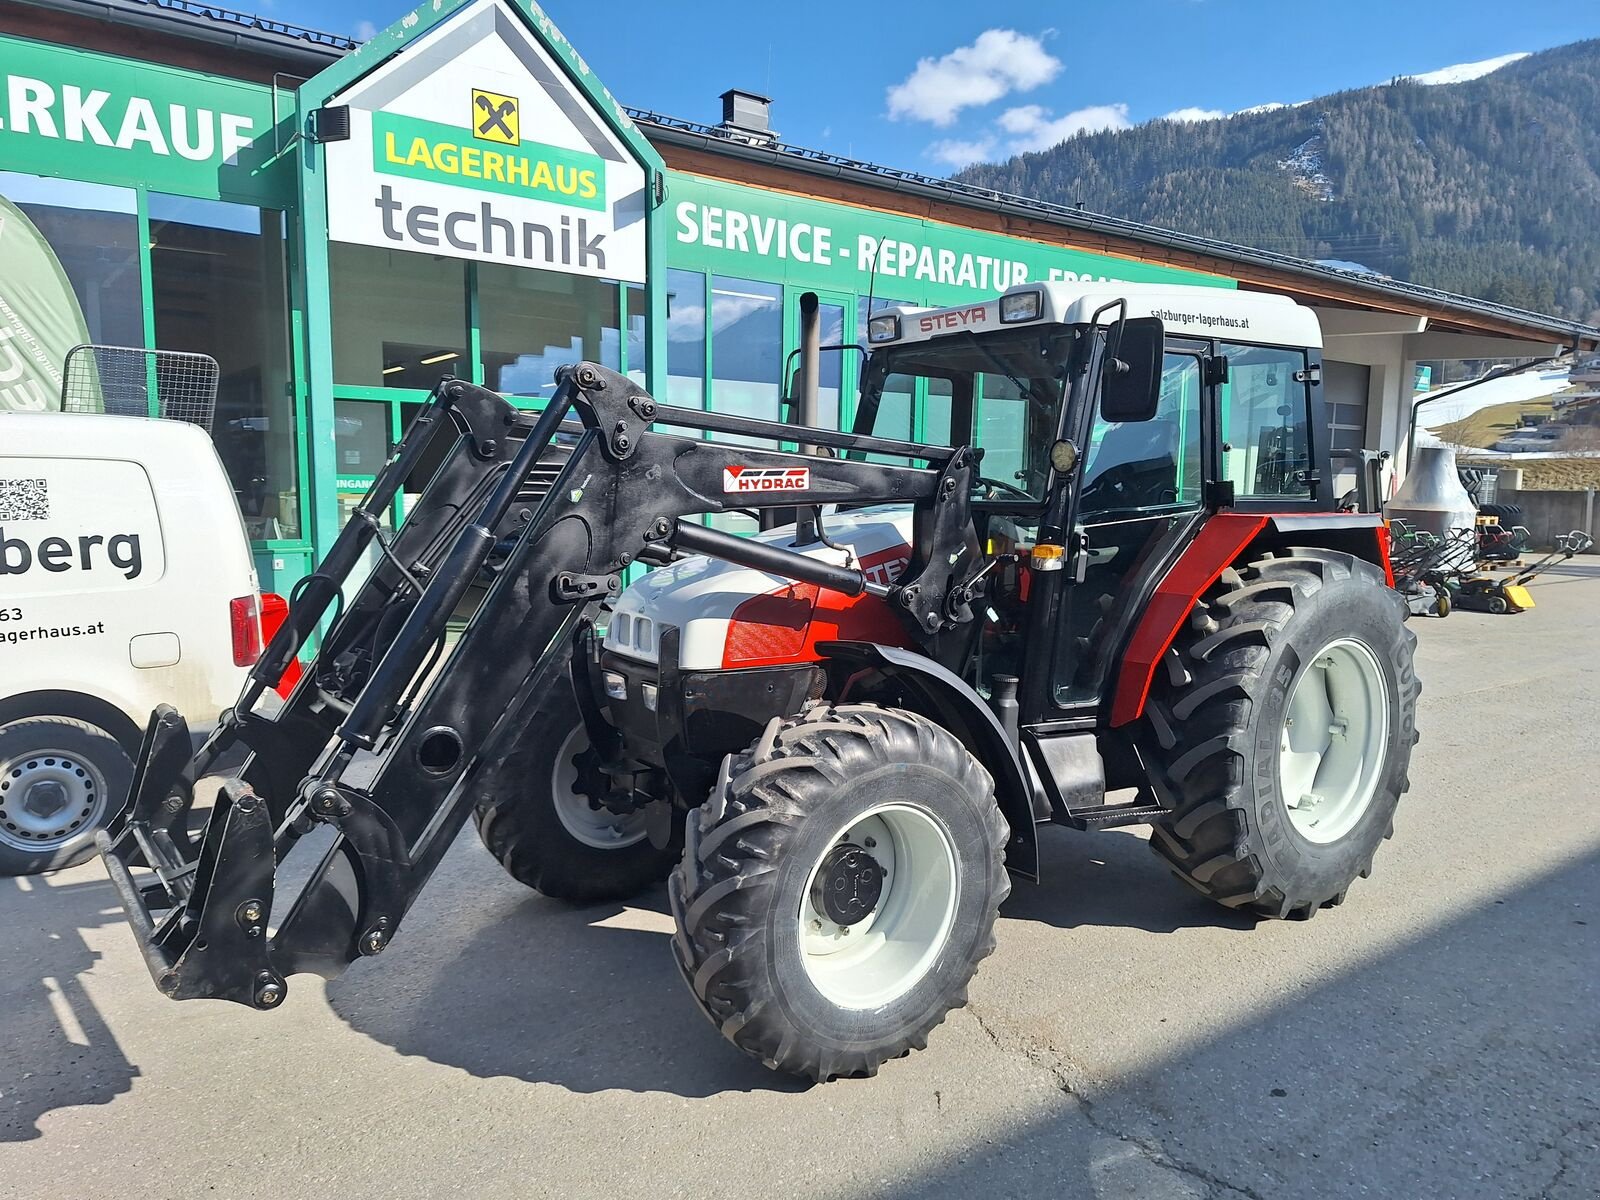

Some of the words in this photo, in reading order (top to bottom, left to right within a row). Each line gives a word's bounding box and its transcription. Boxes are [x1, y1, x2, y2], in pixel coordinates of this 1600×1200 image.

[0, 75, 254, 166] RKAUF
[385, 131, 597, 198] LAGERHAUS
[375, 184, 606, 270] technik
[676, 201, 832, 266] SERVICE
[857, 234, 1029, 293] REPARATUR
[920, 306, 986, 333] STEYR
[1151, 308, 1250, 329] salzburger-lagerhaus.at
[336, 479, 373, 489] INGAN
[738, 477, 805, 490] HYDRAC
[0, 526, 142, 580] berg
[0, 607, 23, 621] 63
